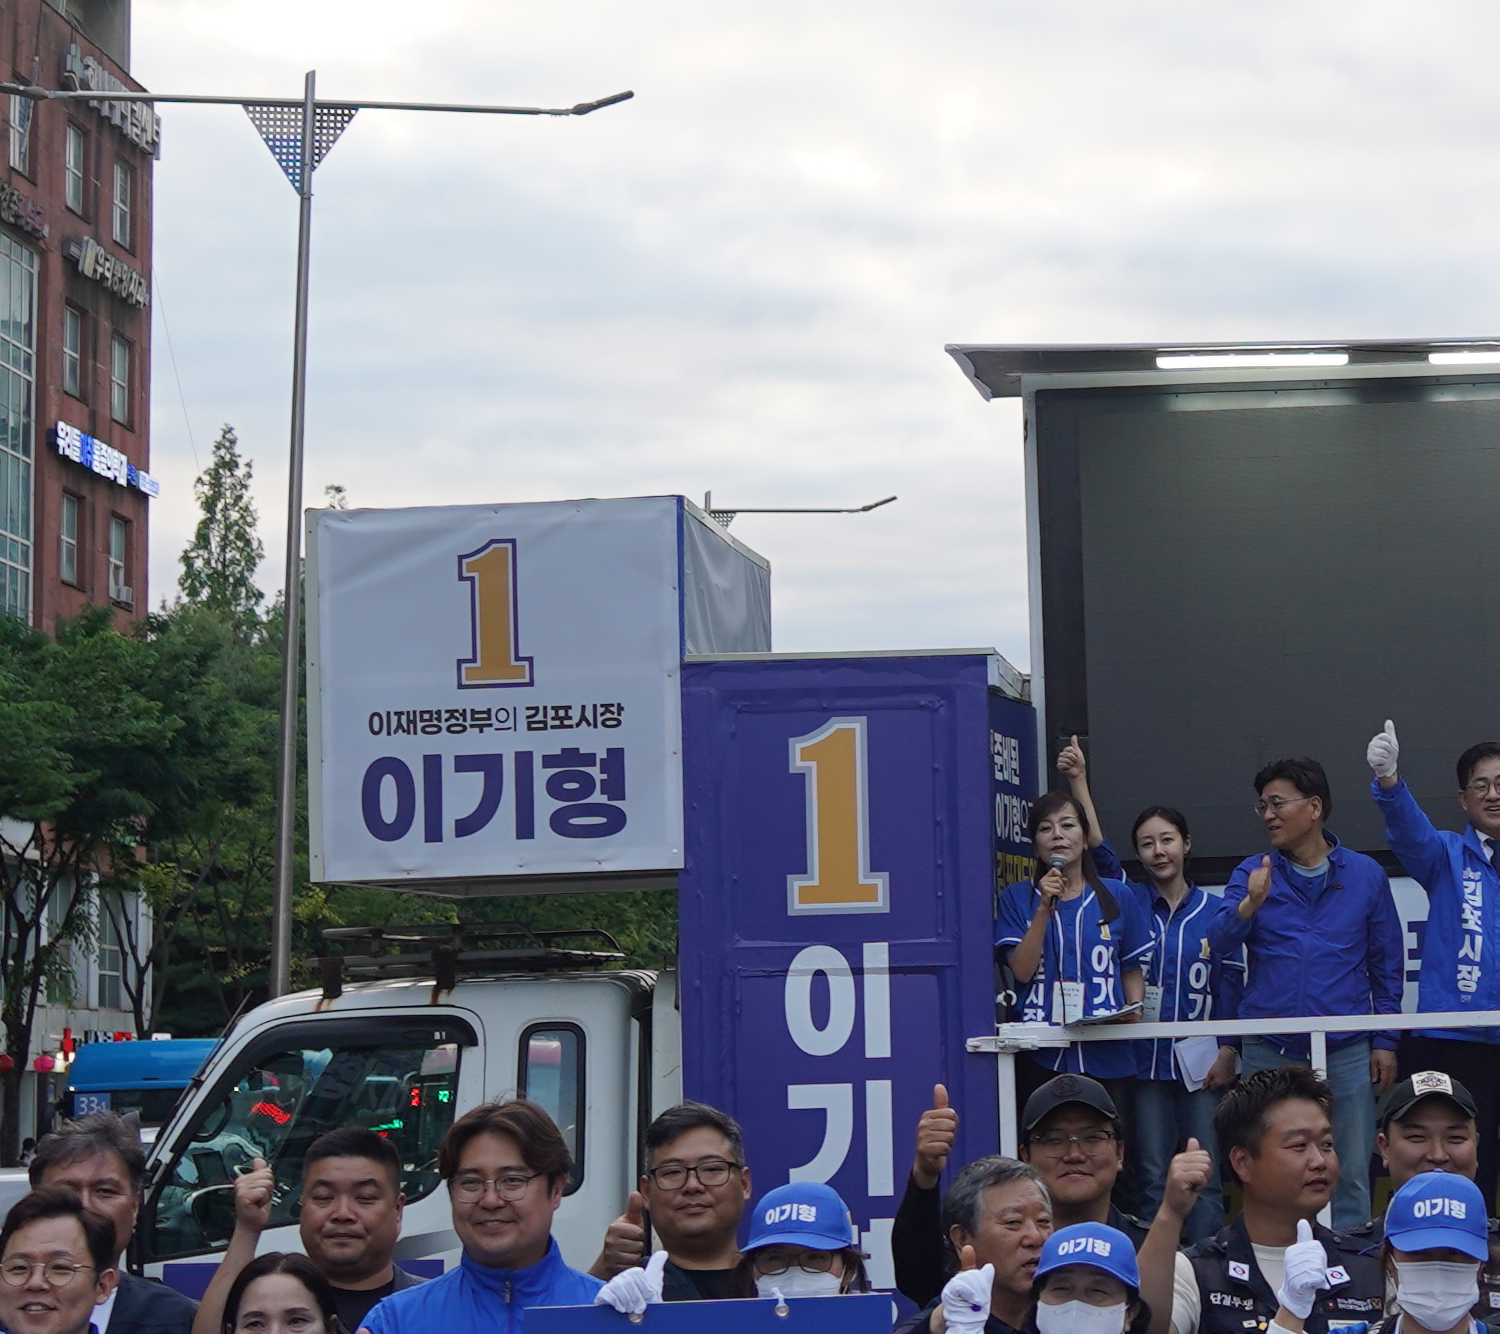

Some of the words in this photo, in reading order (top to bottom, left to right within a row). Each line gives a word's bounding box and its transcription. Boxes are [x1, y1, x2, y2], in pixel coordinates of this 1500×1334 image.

[456, 537, 534, 689] 1
[367, 705, 519, 738] 이재명정부의
[524, 702, 625, 734] 김포시장
[361, 746, 628, 845] 이기형
[786, 715, 891, 916] 1
[1457, 880, 1485, 993] 김포시장
[764, 1203, 818, 1226] 이기형
[1412, 1197, 1467, 1222] 이기형
[1057, 1235, 1112, 1259] 이기형
